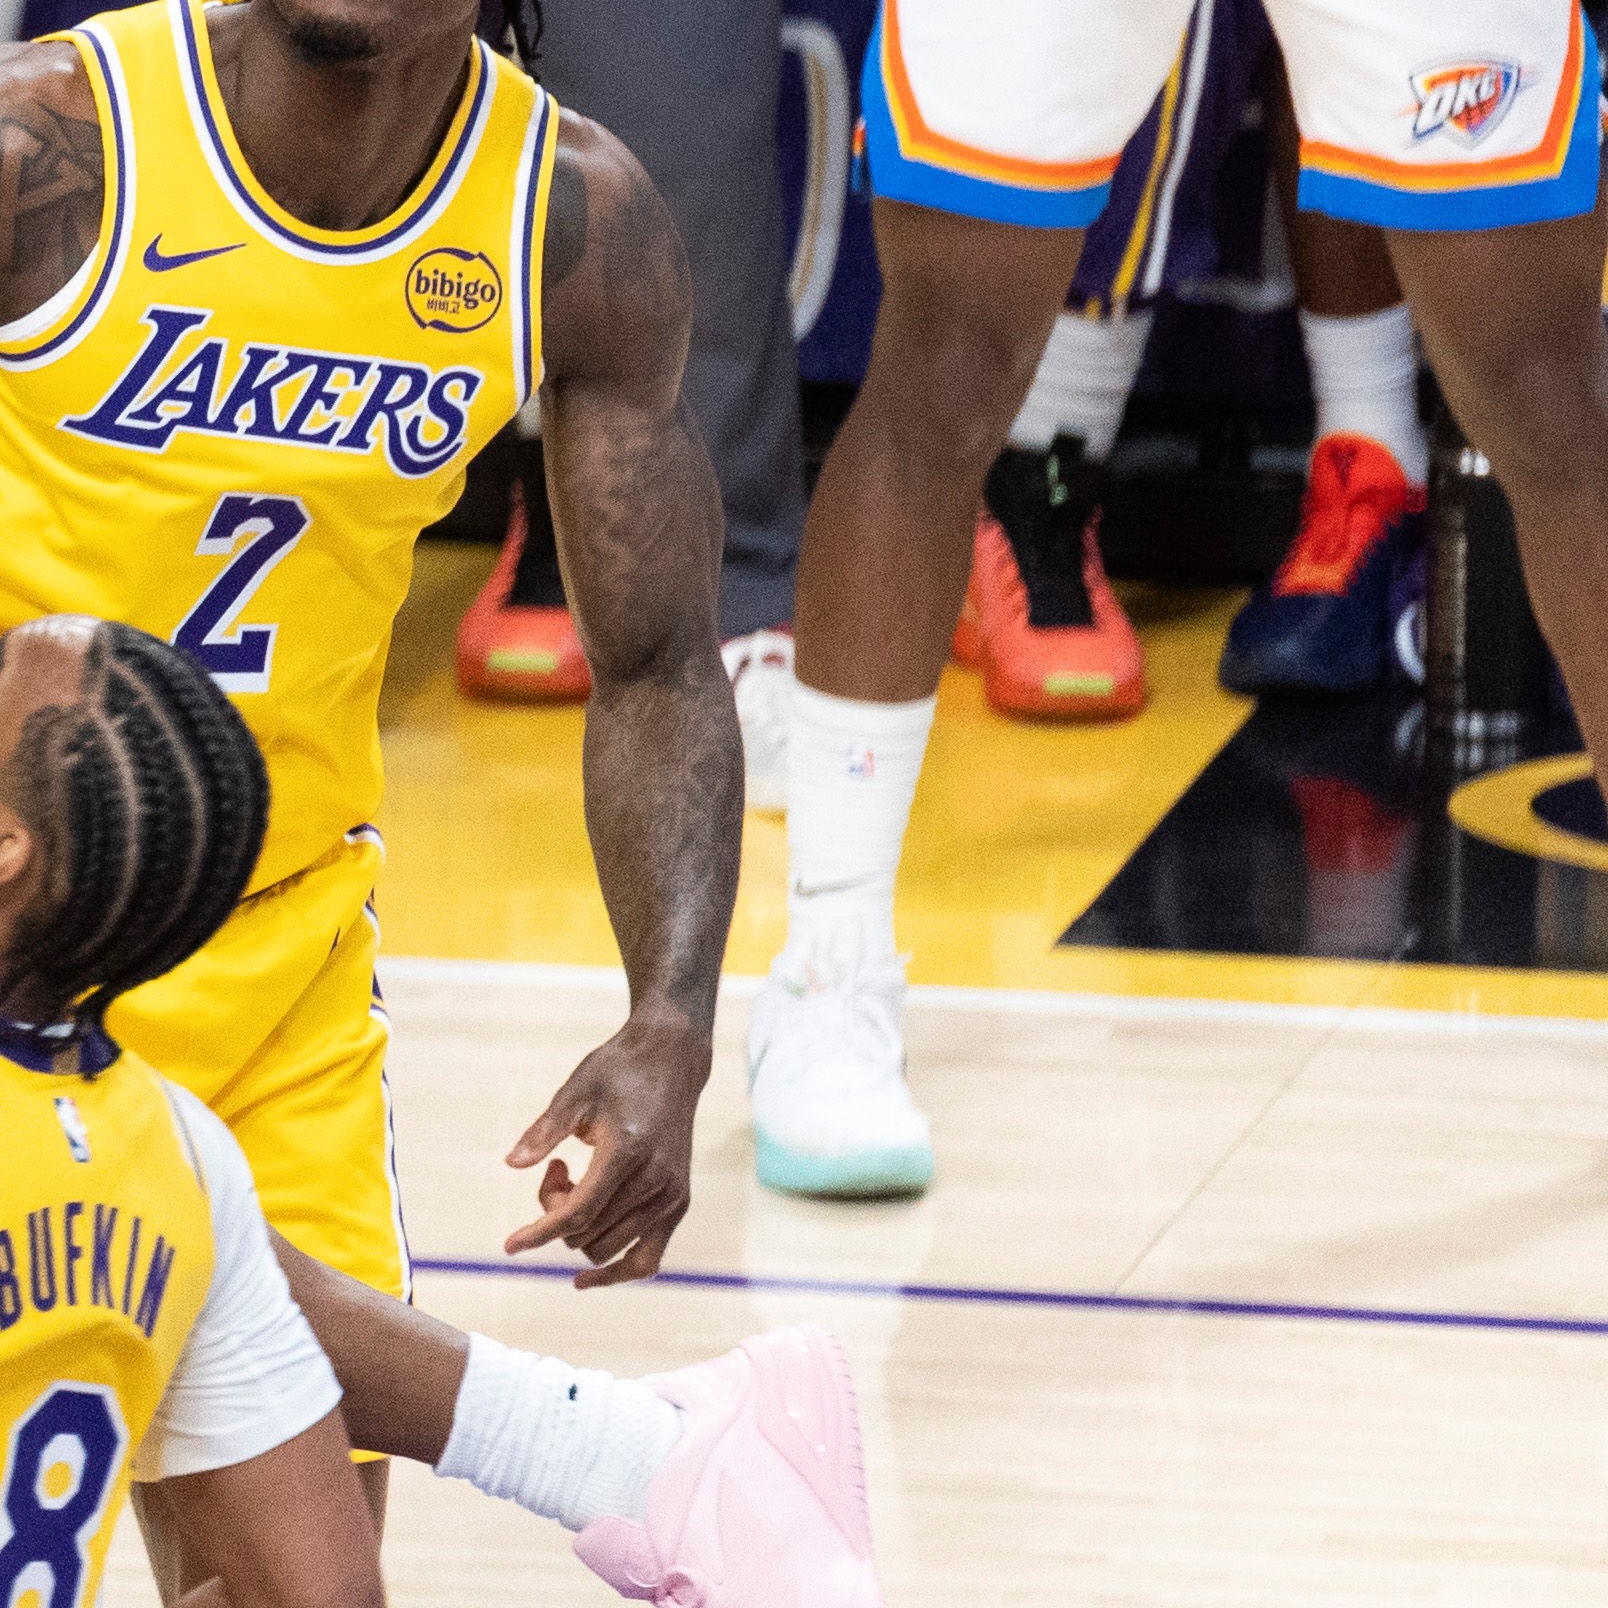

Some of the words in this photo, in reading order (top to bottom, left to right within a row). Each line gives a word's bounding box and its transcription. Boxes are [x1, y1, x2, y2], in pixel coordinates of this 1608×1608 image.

[415, 268, 496, 311] bibigo
[58, 304, 483, 480] LAKERS
[173, 491, 314, 695] 2
